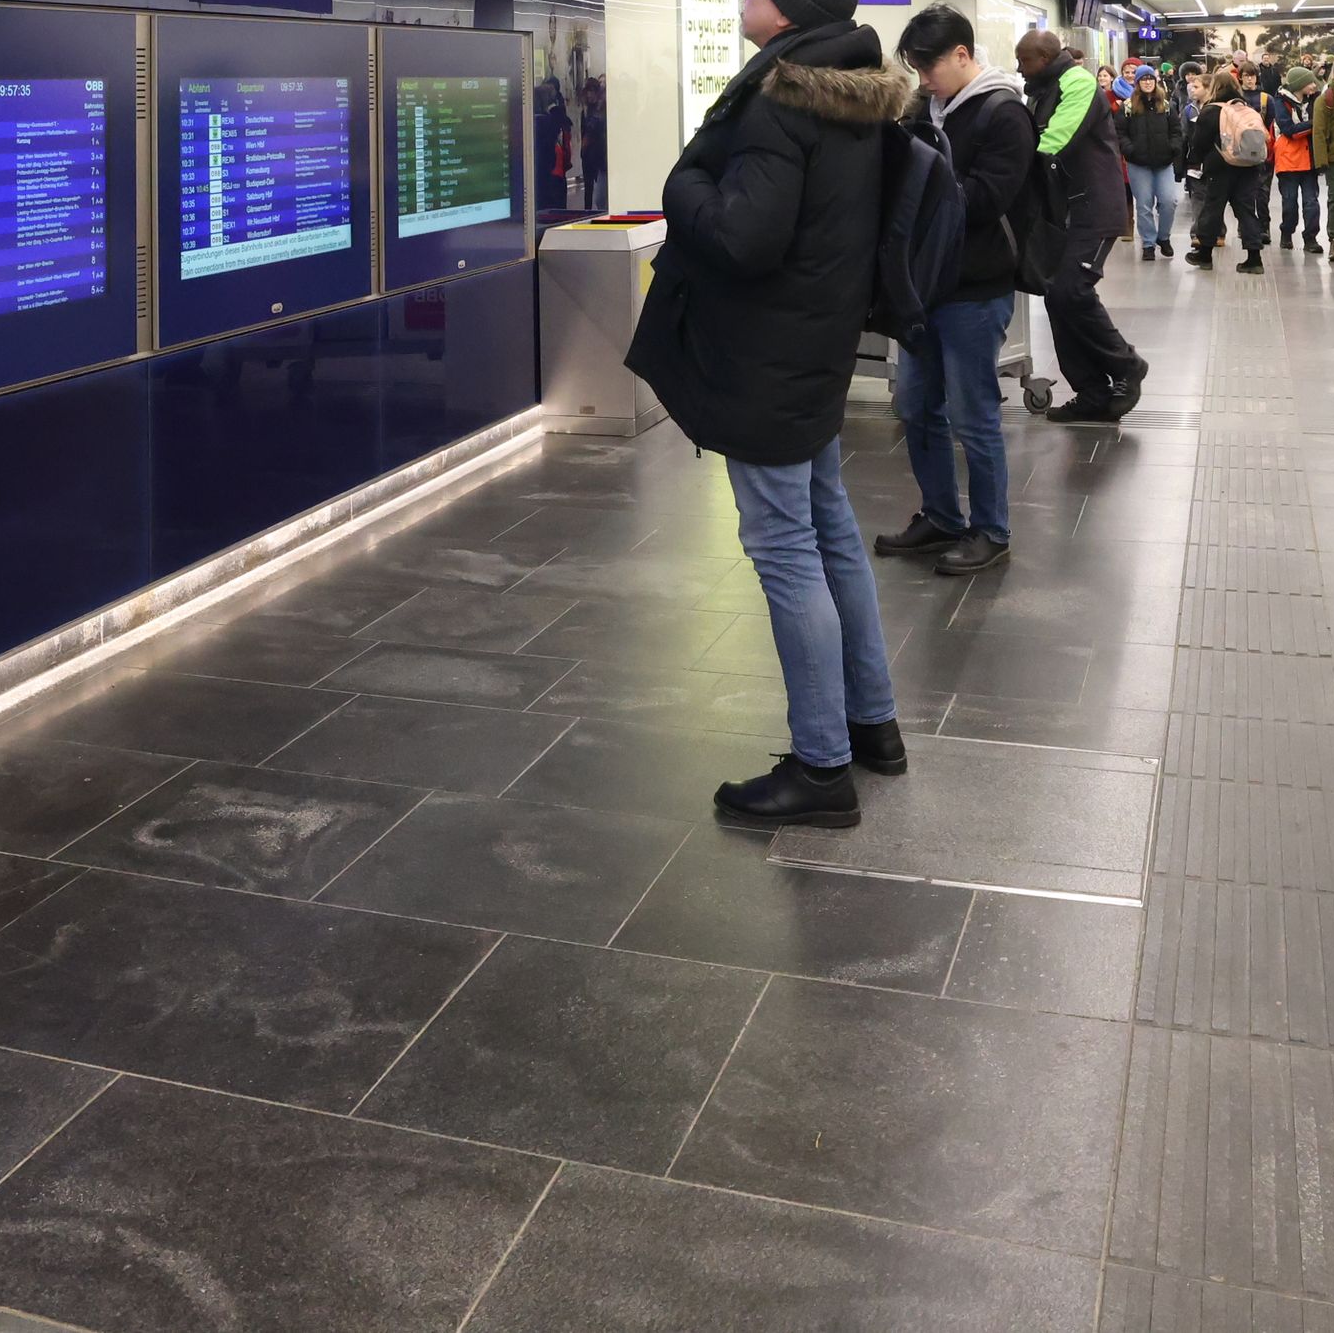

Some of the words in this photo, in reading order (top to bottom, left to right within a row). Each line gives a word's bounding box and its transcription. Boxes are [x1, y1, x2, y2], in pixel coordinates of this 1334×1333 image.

[1141, 27, 1148, 37] 7
[1150, 30, 1157, 39] 8
[693, 40, 715, 63] nicht
[717, 46, 730, 63] am
[85, 80, 103, 91] ÖBB
